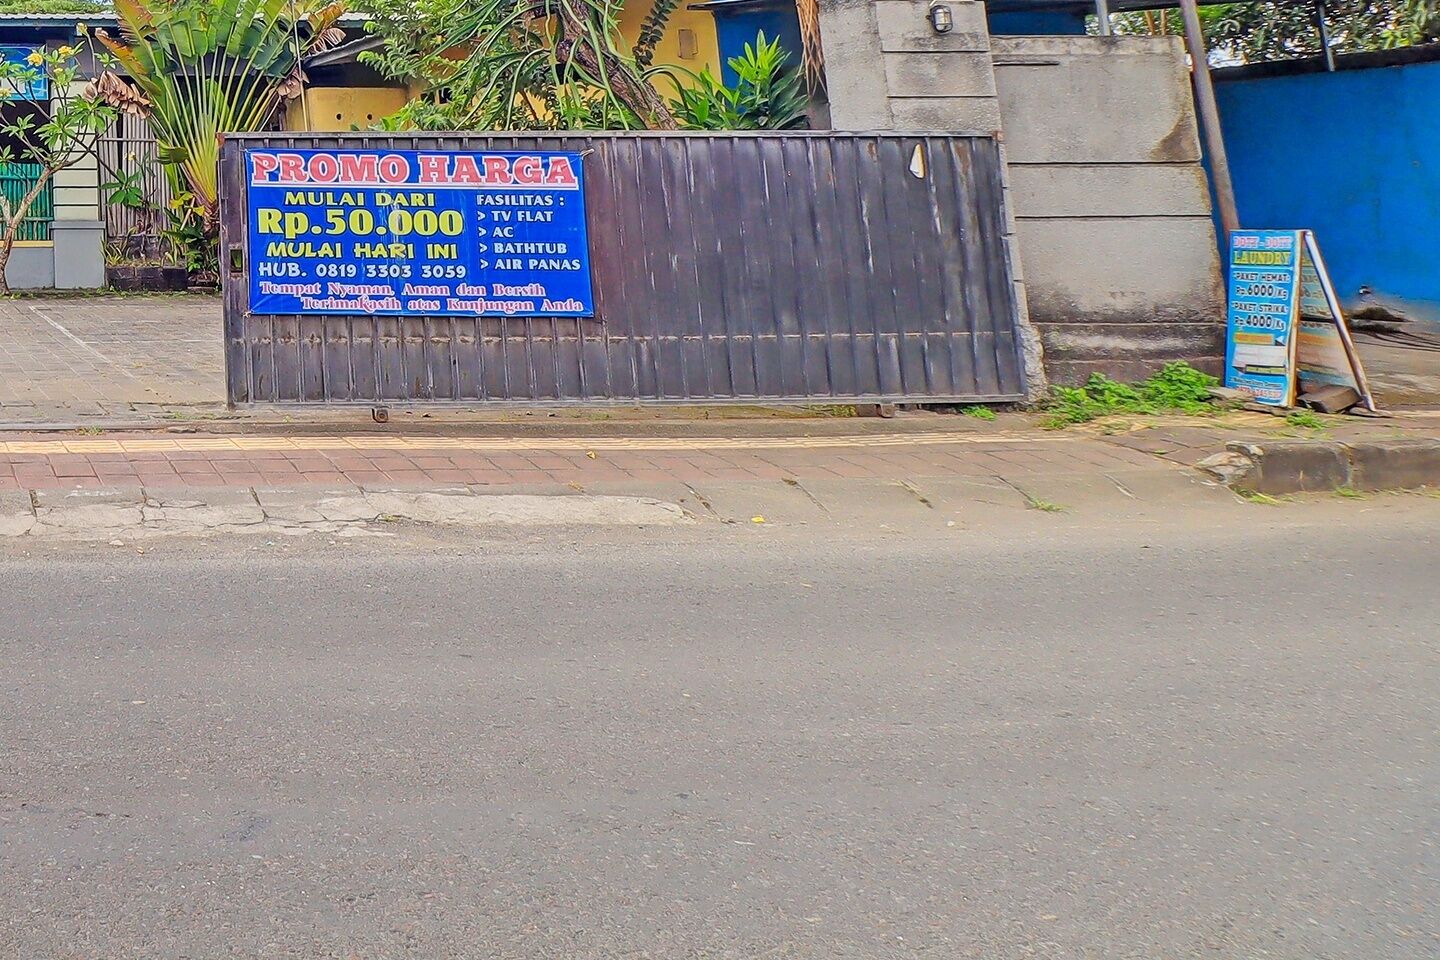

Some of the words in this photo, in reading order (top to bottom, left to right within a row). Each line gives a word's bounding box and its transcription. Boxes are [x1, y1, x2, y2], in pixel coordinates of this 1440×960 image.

[251, 153, 410, 183] PROMO
[418, 154, 578, 184] HARGA
[285, 191, 364, 206] MULAI
[375, 192, 436, 207] DARI
[476, 194, 553, 206] FASILITAS
[257, 208, 464, 240] Rp.50.000
[491, 210, 512, 221] TV
[517, 211, 553, 222] FLAT
[493, 226, 514, 238] AC
[266, 242, 342, 258] MULAI
[354, 243, 414, 259] HARI
[427, 243, 457, 259] INI
[494, 243, 567, 254] BATHTUB
[495, 259, 522, 270] AIR
[529, 259, 581, 271] PANAS
[1234, 250, 1291, 265] LAUNDRY
[259, 262, 307, 277] HUB.
[316, 263, 357, 278] 0819
[366, 264, 411, 278] 3303
[421, 265, 466, 279] 3059
[259, 281, 321, 297] Tempat
[402, 283, 450, 296] Aman
[456, 282, 486, 296] dan
[492, 283, 546, 297] Bersih
[300, 294, 402, 313] Terimakasih
[407, 298, 440, 311] atas
[446, 297, 535, 314] Kunjungan
[541, 298, 583, 311] Anda
